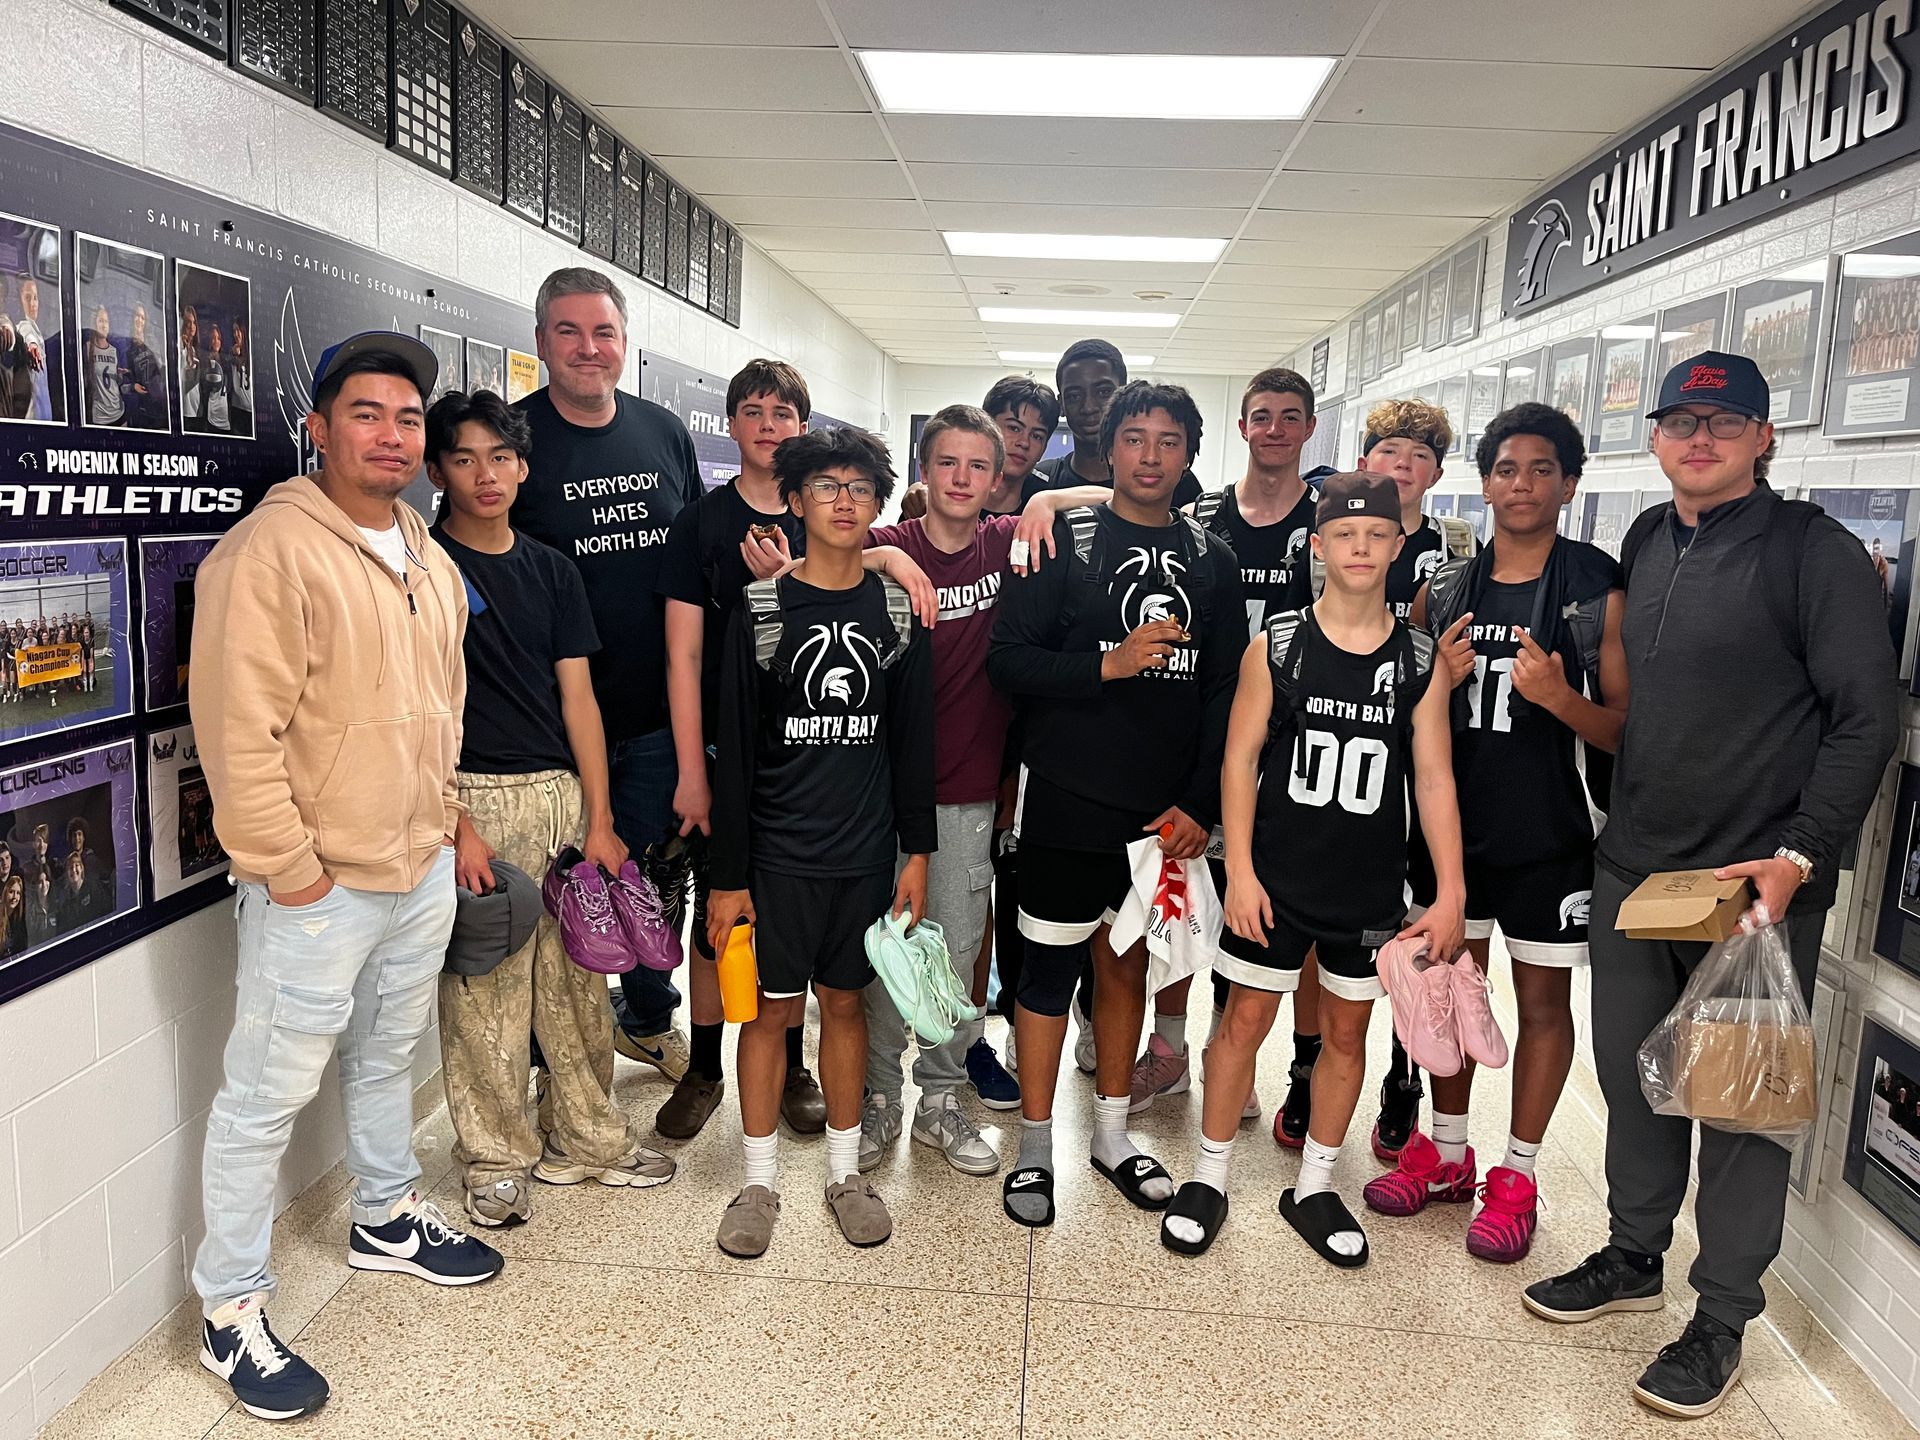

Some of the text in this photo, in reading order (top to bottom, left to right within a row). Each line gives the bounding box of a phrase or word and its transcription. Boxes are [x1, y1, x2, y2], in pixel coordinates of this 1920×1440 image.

[1582, 0, 1913, 267] SAINT FRANCIS
[147, 209, 471, 320] SAINT FRANCIS CATHOLIC SECONDARY SCHOOL
[689, 409, 730, 438] ATHLE
[46, 449, 199, 477] PHOENIX IN SEASON
[0, 484, 243, 516] ATHLETICS
[563, 472, 659, 501] EVERYBODY
[592, 501, 649, 526] HATES
[575, 527, 670, 556] NORTH BAY
[936, 571, 1001, 610] ONQUIN
[1463, 624, 1507, 642] RTH
[26, 648, 71, 663] Niagara Cup
[29, 659, 70, 675] Champions
[1168, 647, 1199, 673] BAY
[1142, 671, 1194, 680] ETBALL
[1306, 696, 1395, 725] NORTH BAY
[785, 714, 879, 739] NORTH BAY
[784, 738, 875, 746] BASKETBALL
[0, 756, 86, 795] CURLING
[1287, 729, 1389, 815] 00
[1016, 1172, 1041, 1182] NIKE
[1136, 1159, 1154, 1170] NIKE
